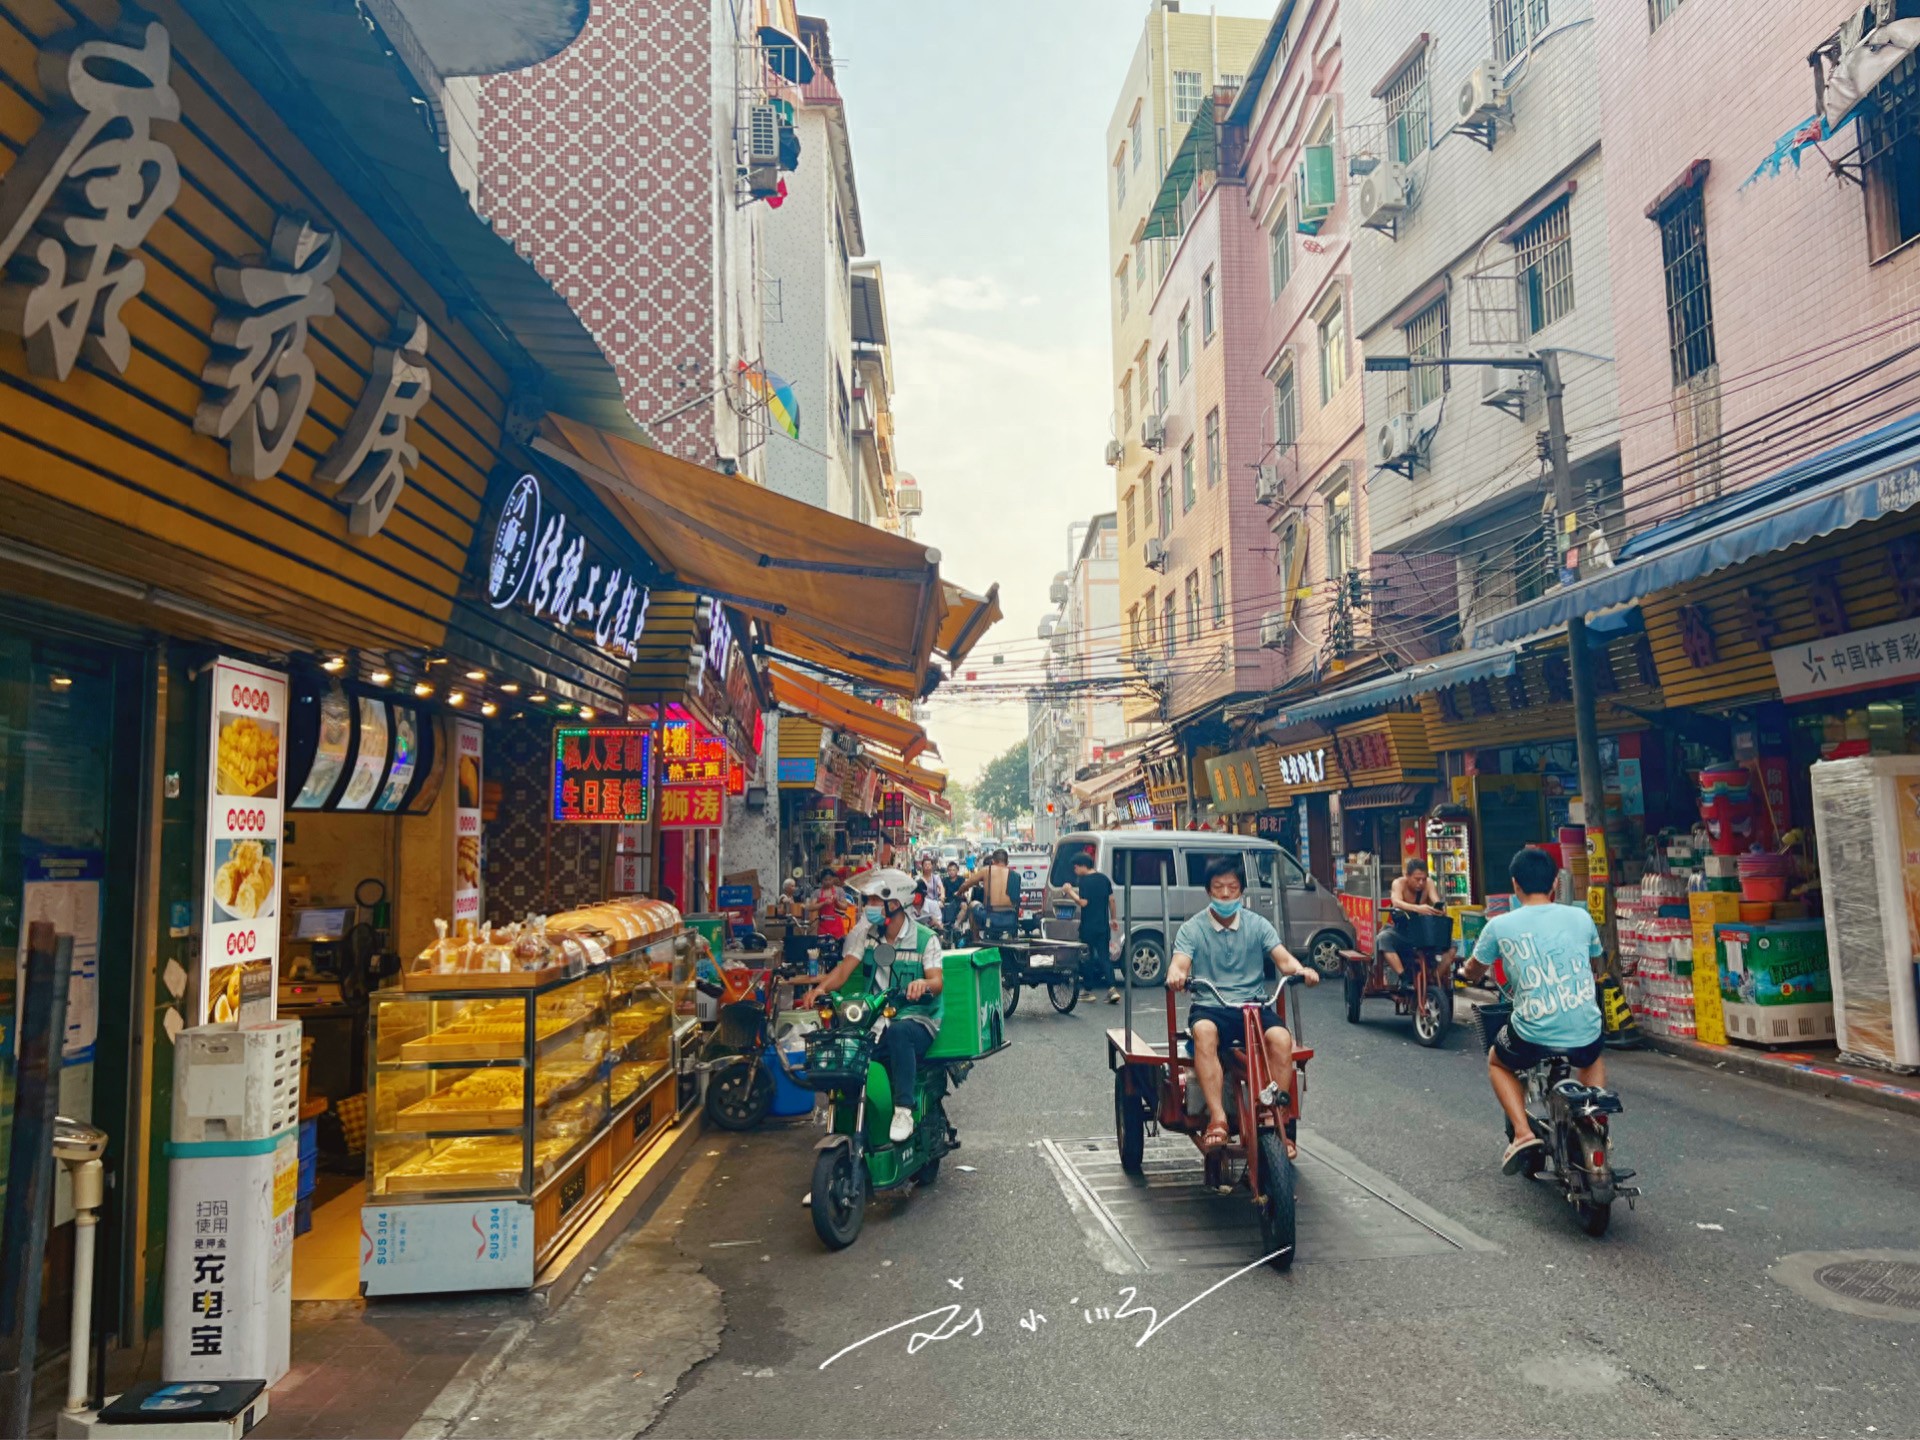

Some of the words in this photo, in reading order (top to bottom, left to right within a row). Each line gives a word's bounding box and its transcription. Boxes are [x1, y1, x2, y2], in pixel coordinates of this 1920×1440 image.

[563, 736, 642, 771] 私人定制
[668, 762, 720, 780] 热干面
[561, 777, 642, 815] 生日蛋糕
[661, 788, 720, 822] 狮涛
[1260, 816, 1287, 832] 印花厂
[1498, 932, 1541, 967] PUT
[196, 1200, 228, 1217] 扫码
[489, 1207, 500, 1230] 304
[195, 1217, 228, 1234] 使用
[377, 1212, 388, 1235] 304
[377, 1238, 388, 1265] SUS
[489, 1233, 500, 1260] SUS
[190, 1253, 227, 1356] 充电宝
